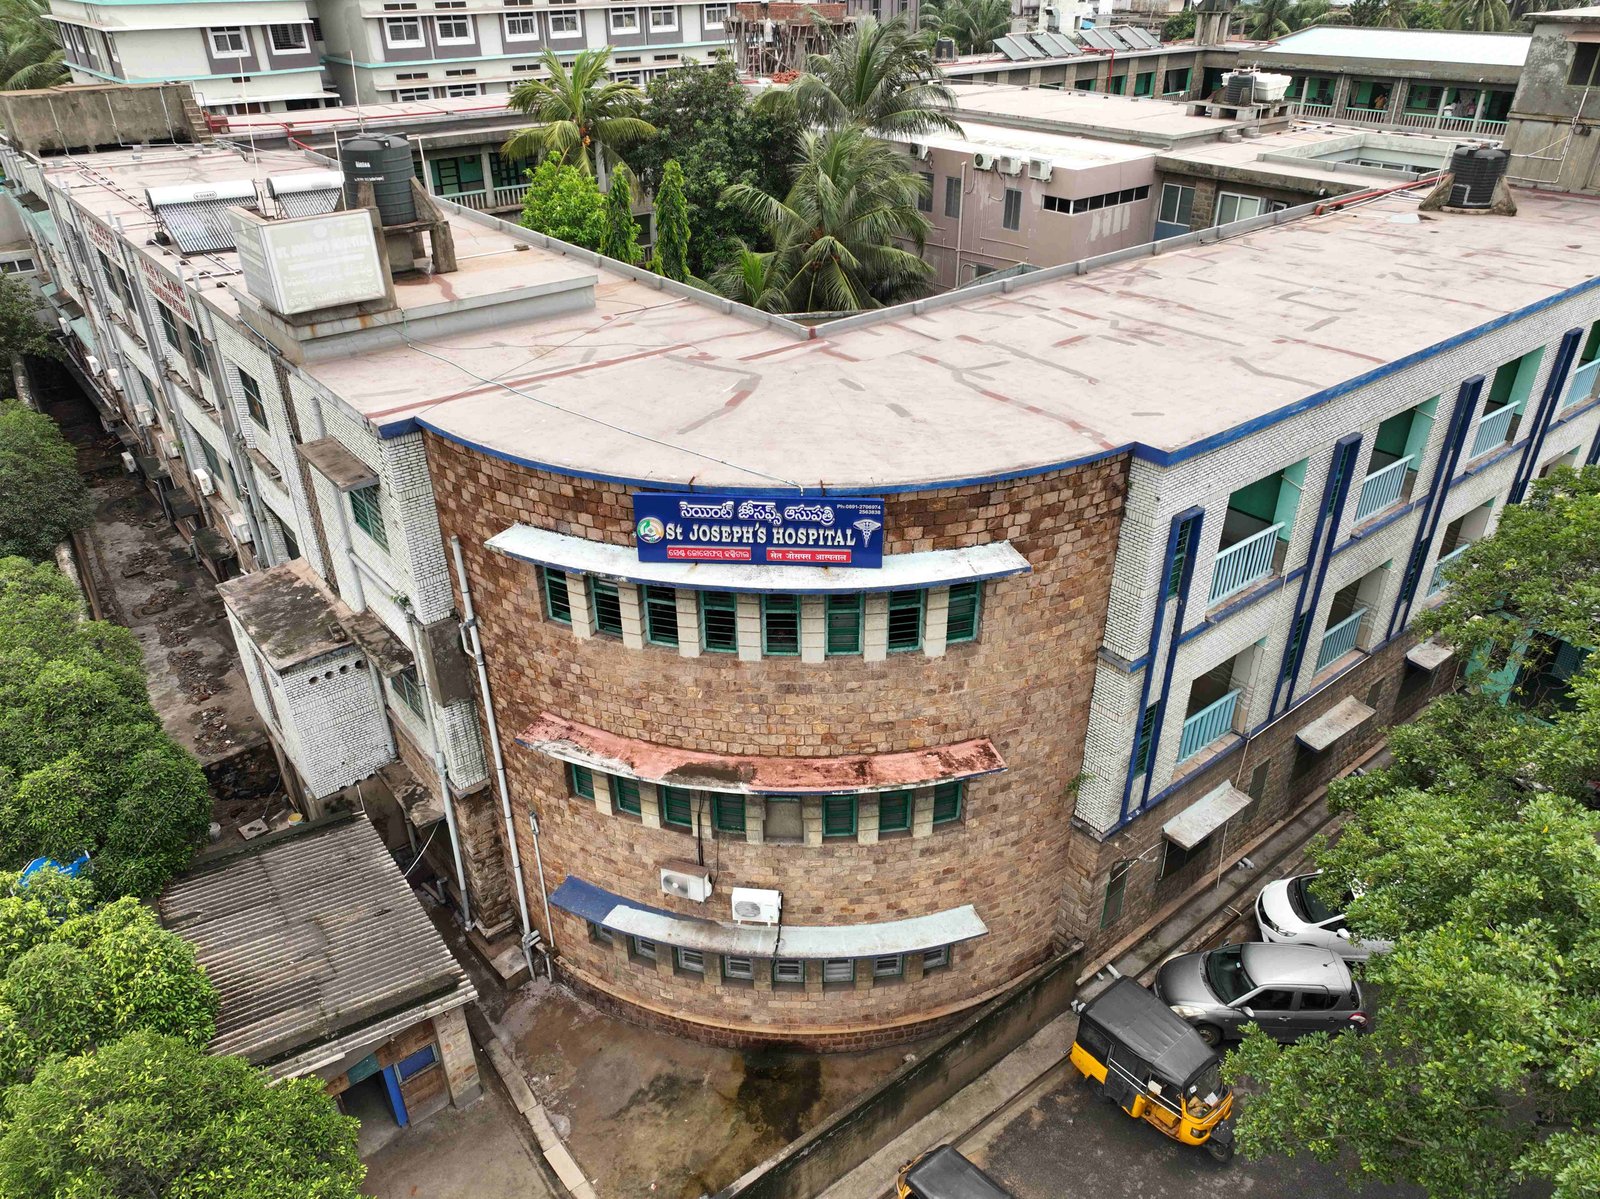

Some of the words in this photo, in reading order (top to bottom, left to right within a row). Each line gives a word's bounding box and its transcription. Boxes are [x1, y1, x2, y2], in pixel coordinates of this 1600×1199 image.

[784, 503, 835, 525] ఆసుపత్రి
[666, 522, 684, 541] St
[689, 522, 767, 545] JOSEPH'S
[772, 526, 856, 547] HOSPITAL
